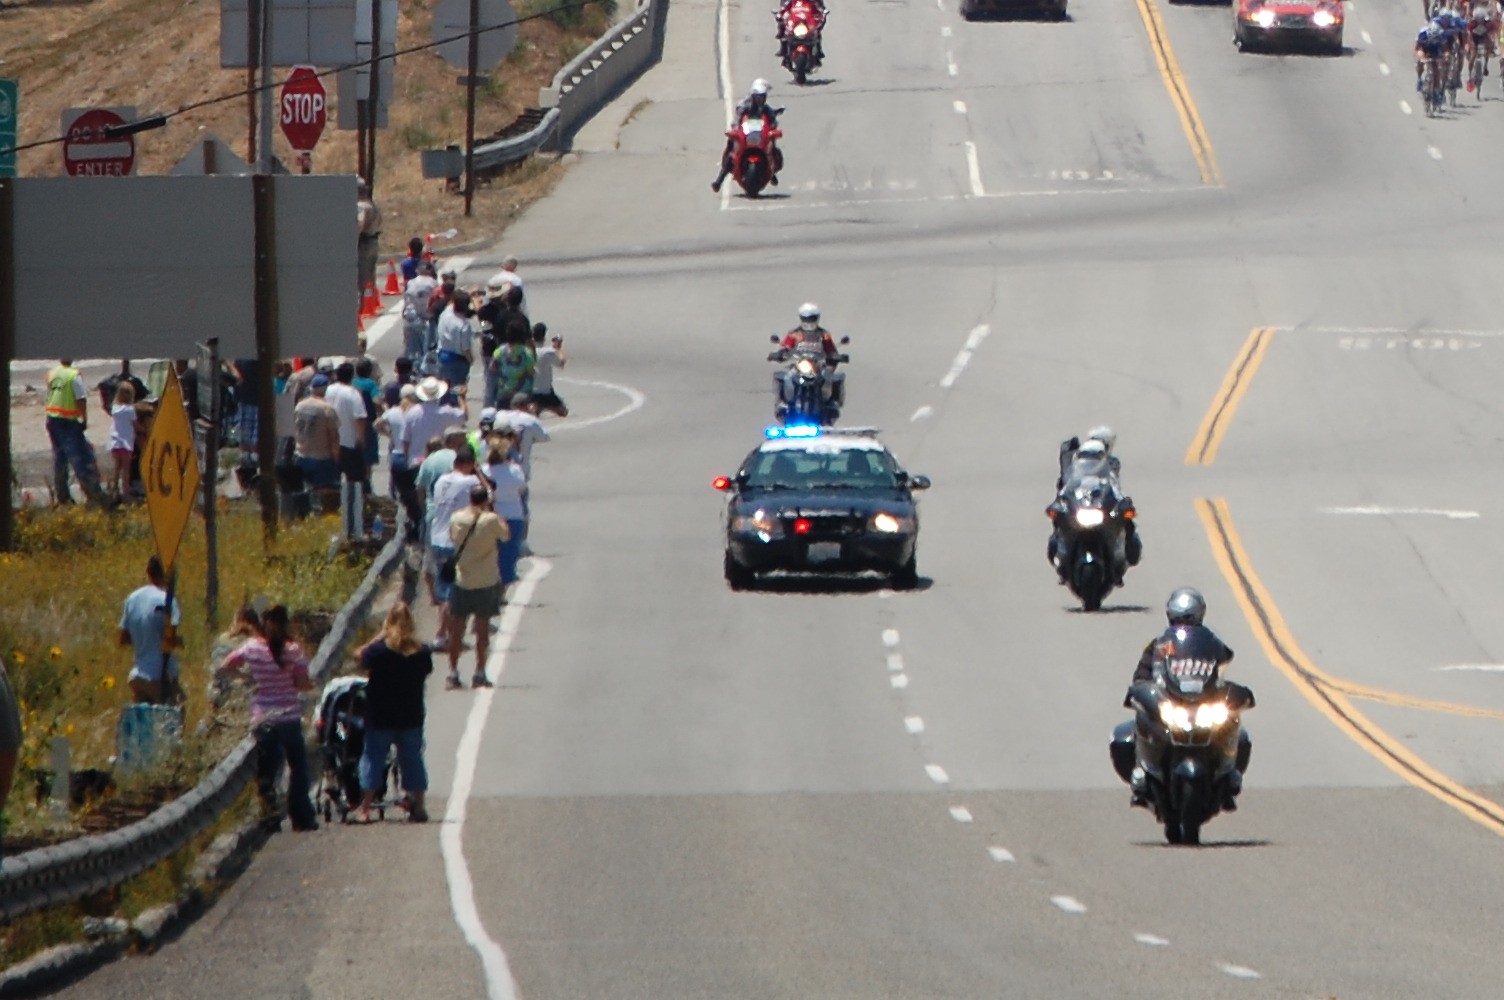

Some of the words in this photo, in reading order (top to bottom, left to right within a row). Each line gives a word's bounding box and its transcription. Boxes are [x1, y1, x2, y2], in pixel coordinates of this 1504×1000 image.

[282, 93, 324, 125] STOP
[76, 162, 123, 177] ENTER
[148, 439, 192, 501] ICY
